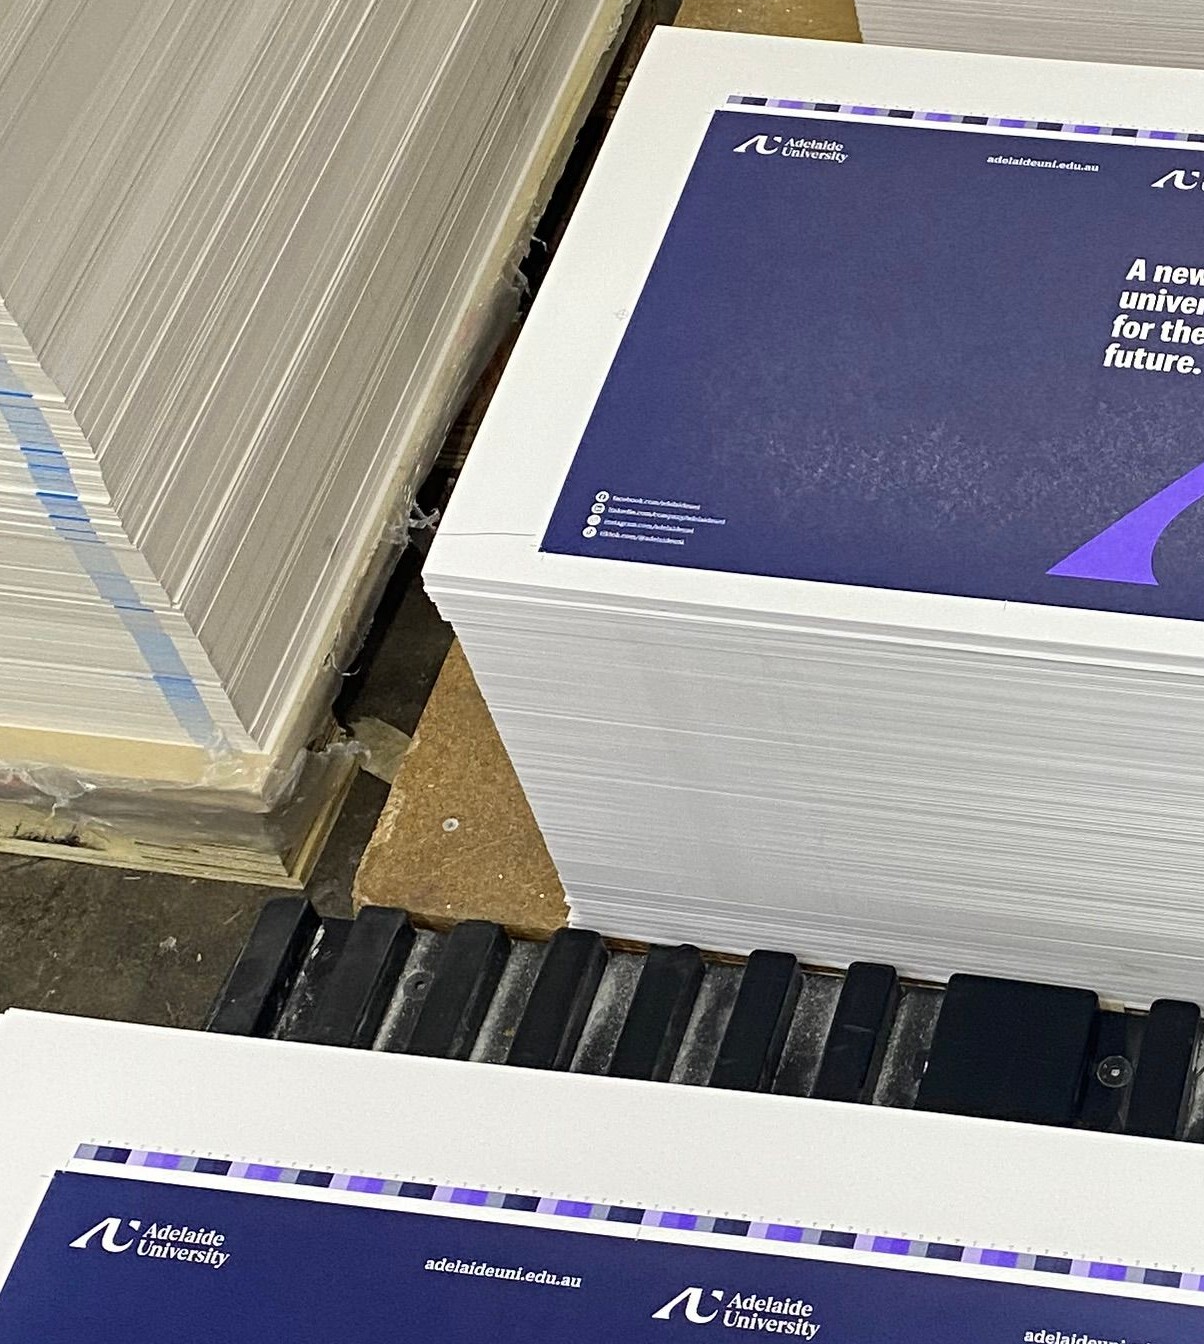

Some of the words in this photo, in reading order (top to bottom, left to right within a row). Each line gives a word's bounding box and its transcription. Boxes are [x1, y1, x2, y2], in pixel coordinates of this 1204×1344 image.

[781, 147, 848, 164] University
[783, 137, 844, 152] Adelaide
[986, 155, 1099, 172] adelaideuni.edu.au
[1125, 258, 1147, 282] A
[1111, 314, 1155, 340] for
[1103, 343, 1202, 374] future.
[142, 1222, 225, 1248] Adelaide
[136, 1238, 231, 1270] University
[424, 1257, 583, 1289] adelaideuni.edu.au
[727, 1292, 814, 1318] Adelaide
[722, 1309, 821, 1341] University
